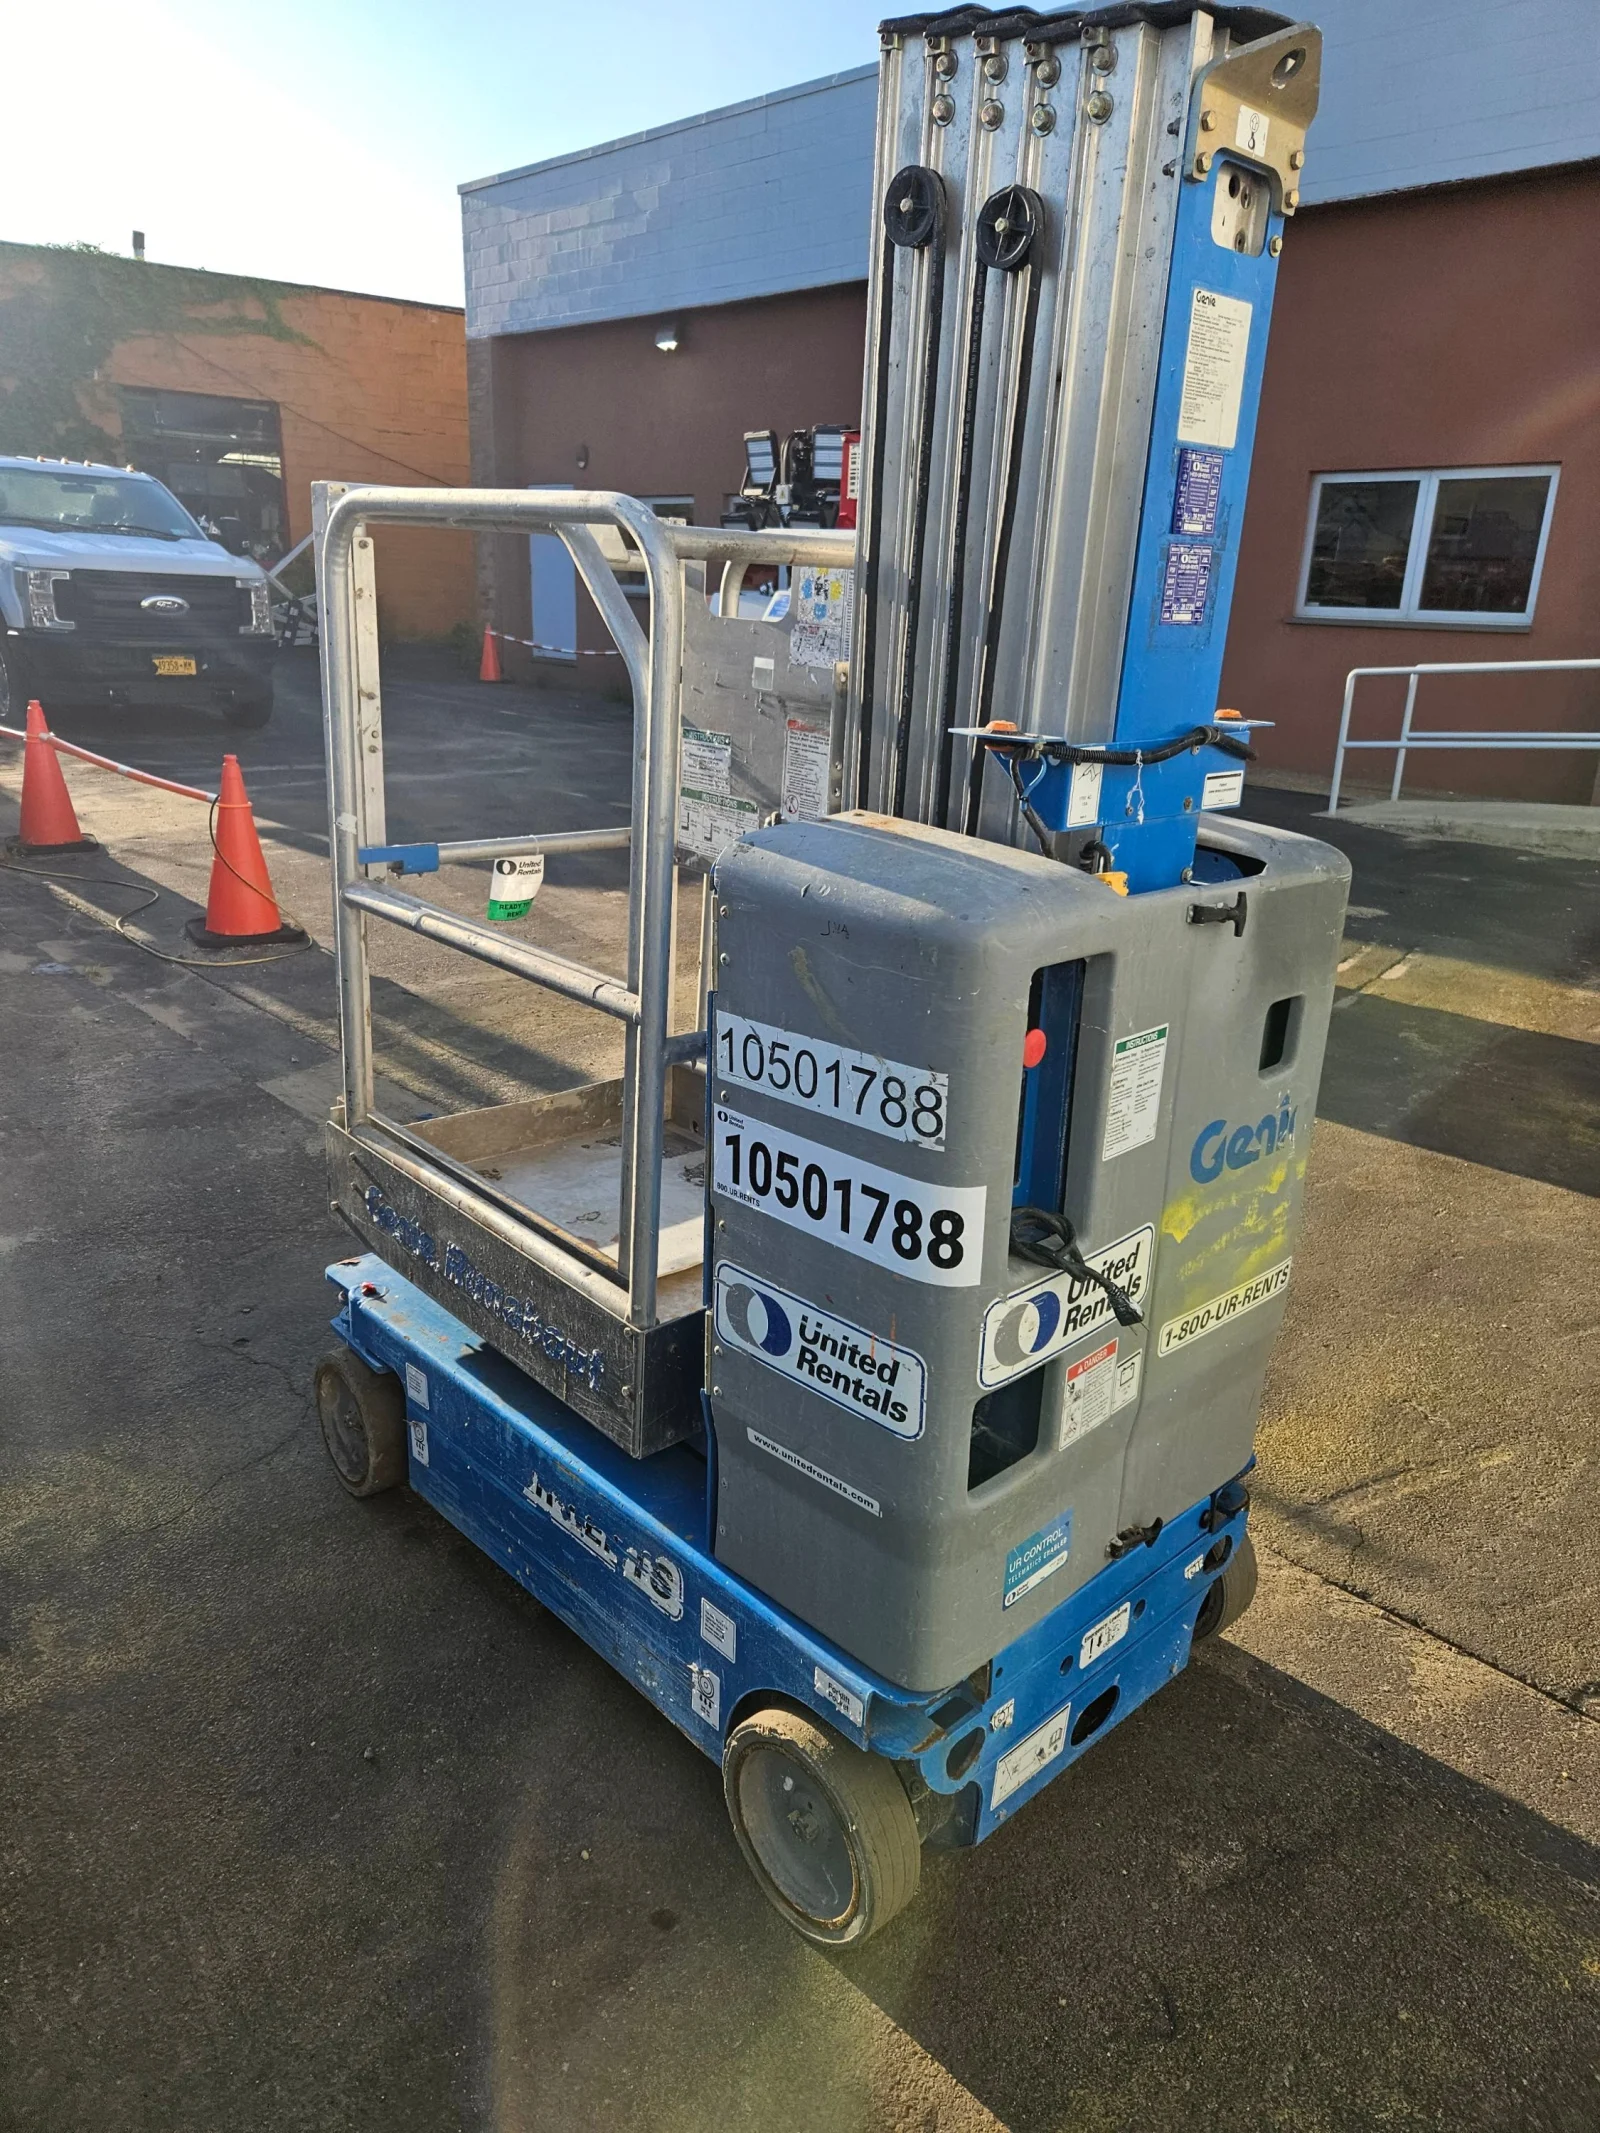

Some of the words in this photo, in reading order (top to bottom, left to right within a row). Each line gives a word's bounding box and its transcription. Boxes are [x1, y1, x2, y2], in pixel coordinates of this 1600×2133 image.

[1196, 290, 1216, 307] Genie
[516, 868, 542, 876] Rentals
[518, 860, 542, 869] United
[1125, 1030, 1159, 1050] INSTRUCTIONS
[720, 1027, 944, 1139] 10501788
[1191, 1093, 1299, 1184] Geni
[717, 1181, 761, 1208] 800.UR.RENTS
[725, 1134, 965, 1270] 10501788
[1062, 1273, 1142, 1337] Renls
[1165, 1264, 1290, 1348] 1-800-UR-RENTS
[798, 1314, 900, 1387] United
[1084, 1348, 1108, 1371] DANGER
[796, 1345, 909, 1423] Rentals
[753, 1434, 875, 1509] www.unitedrentals.com
[1008, 1557, 1042, 1585] TELEMATICS
[1043, 1536, 1068, 1559] ENABLED
[1009, 1557, 1022, 1574] UR
[1023, 1528, 1063, 1563] CONTROL
